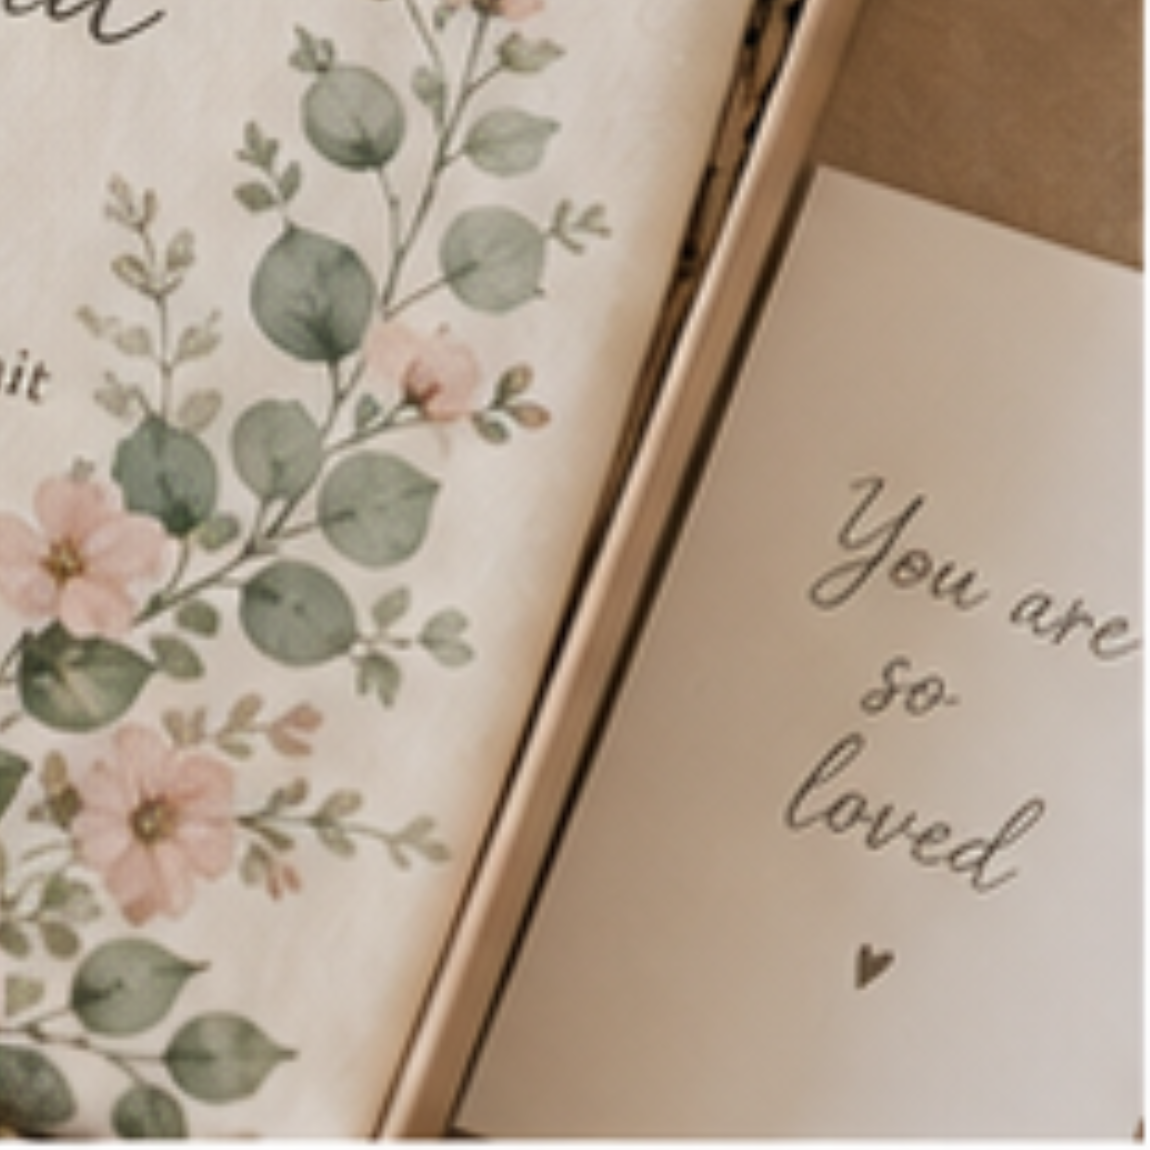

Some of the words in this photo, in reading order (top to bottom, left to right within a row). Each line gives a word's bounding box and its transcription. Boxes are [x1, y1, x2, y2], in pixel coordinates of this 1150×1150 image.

[807, 476, 988, 610] You
[1009, 589, 1140, 659] are
[859, 656, 957, 715] so
[784, 732, 1045, 893] loved
